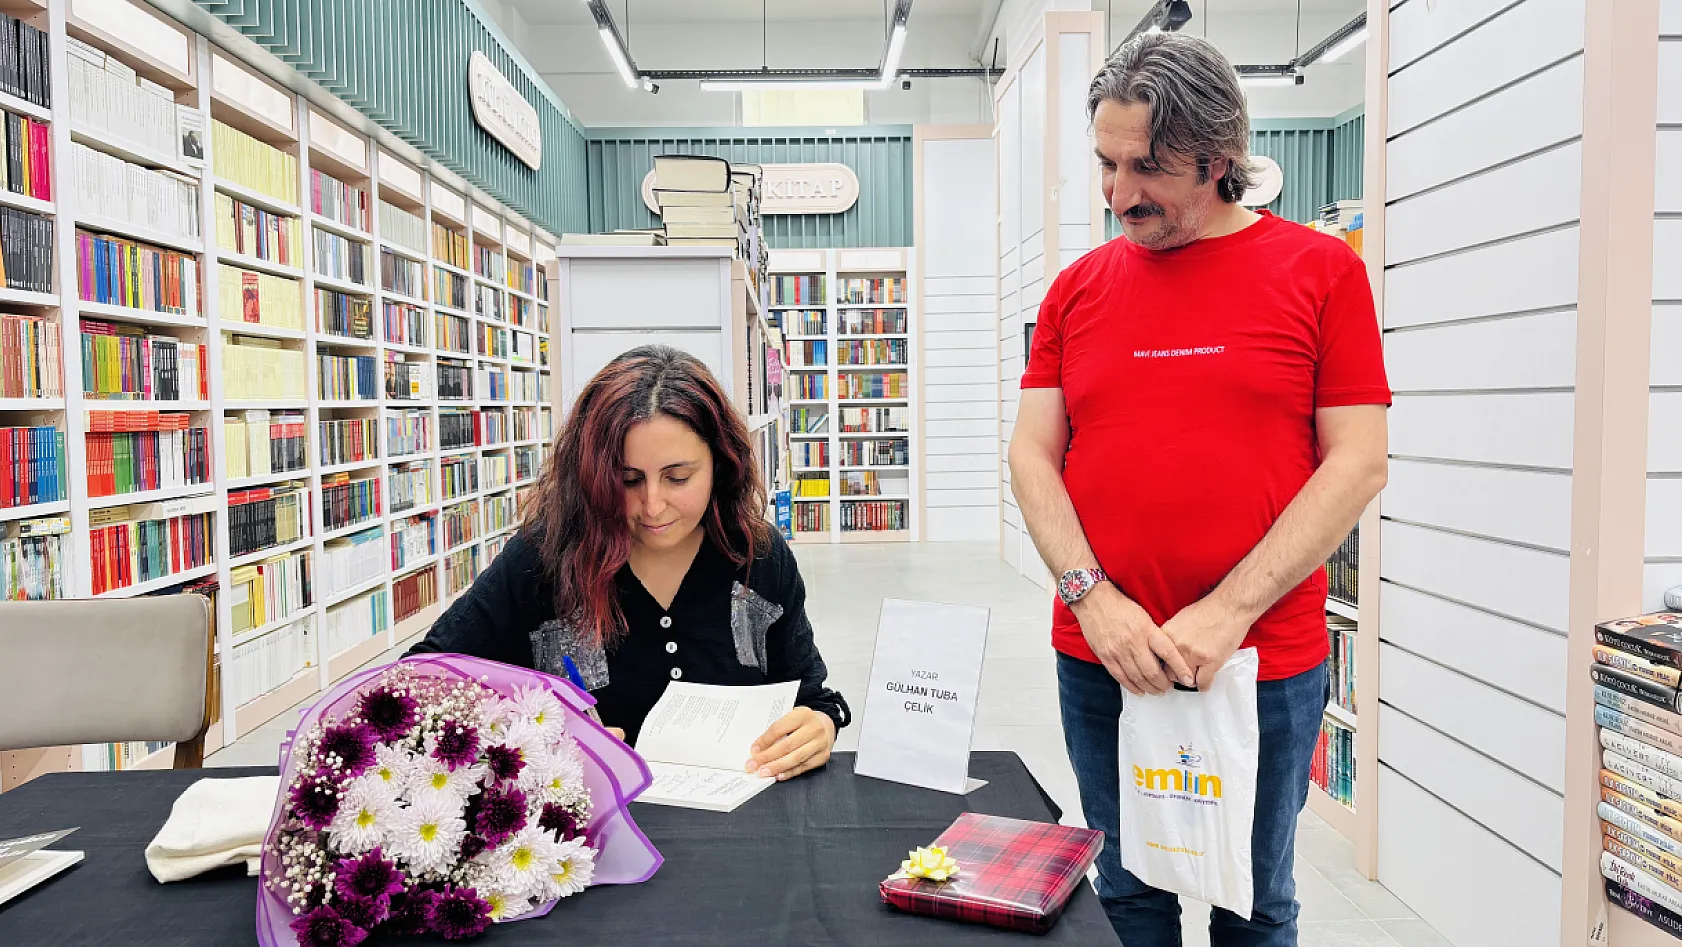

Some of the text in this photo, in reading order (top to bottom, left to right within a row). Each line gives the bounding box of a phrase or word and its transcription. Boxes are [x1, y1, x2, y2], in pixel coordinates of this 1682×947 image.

[765, 177, 844, 199] KİTAP
[1194, 346, 1225, 355] PRODUCT
[911, 669, 939, 681] YAZAR
[886, 681, 958, 701] GÜLHAN TUBA
[904, 701, 934, 714] ÇELİK
